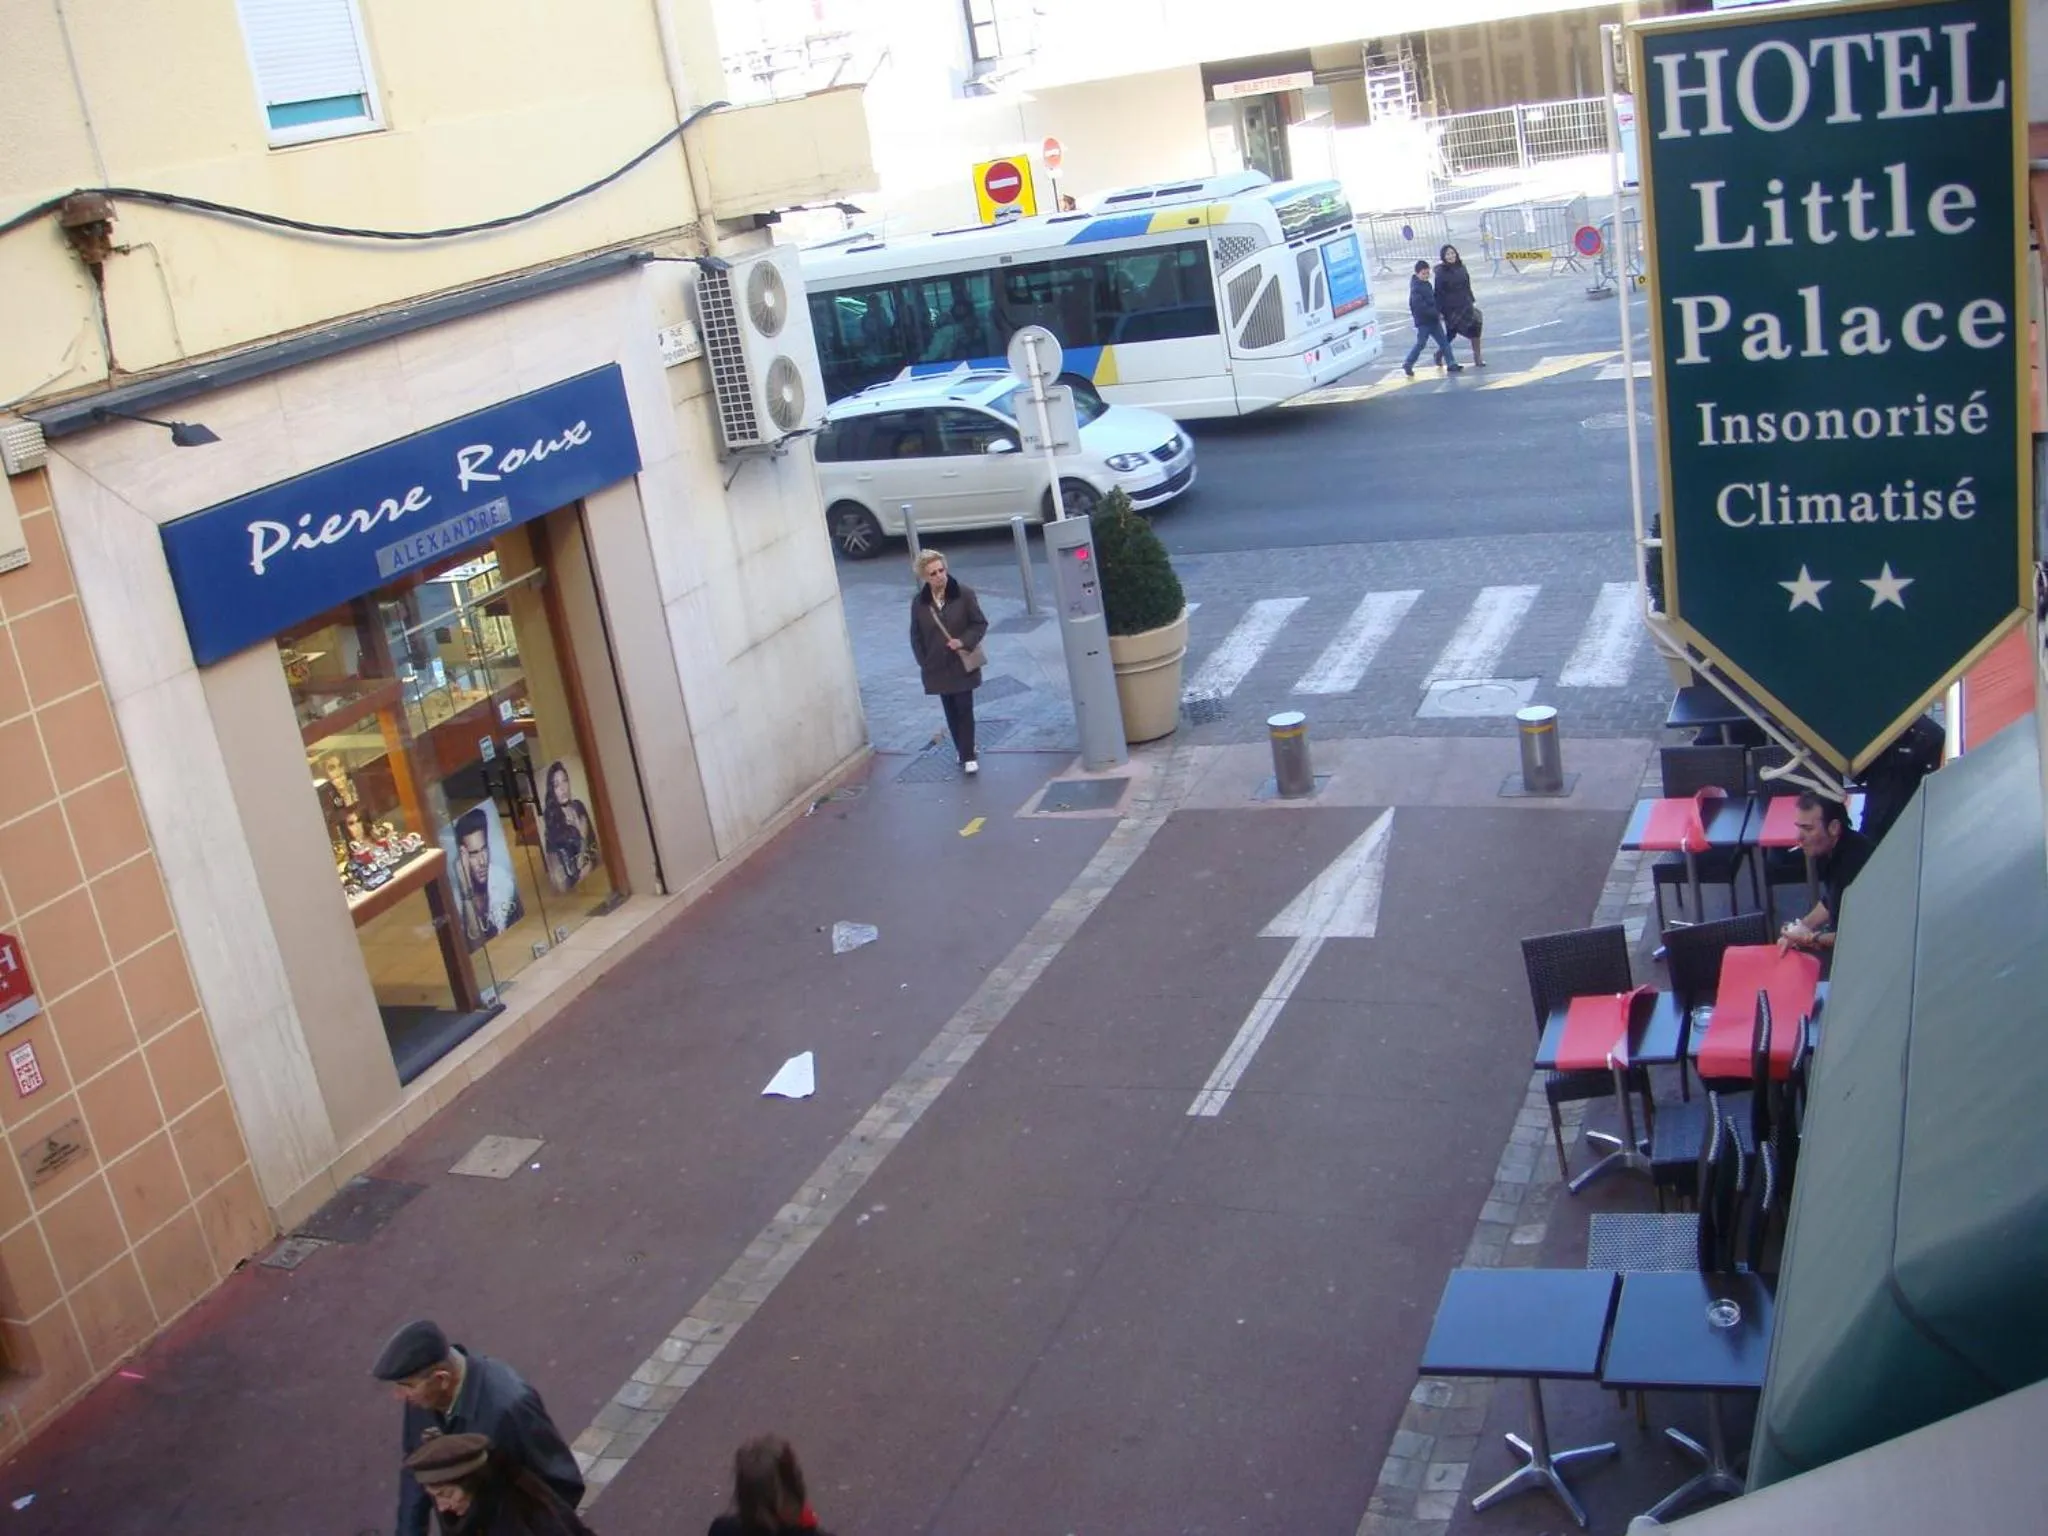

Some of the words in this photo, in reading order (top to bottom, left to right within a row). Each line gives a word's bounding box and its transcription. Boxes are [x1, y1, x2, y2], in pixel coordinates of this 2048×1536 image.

[1653, 22, 2005, 140] HOTEL
[1690, 162, 1977, 252] Little
[1672, 285, 2006, 365] Palace
[1696, 390, 1989, 446] Insonorisé
[247, 485, 432, 576] Pierre
[457, 419, 592, 492] Roux
[1717, 477, 1976, 527] Climatisé
[391, 508, 500, 570] ALEXANDRE
